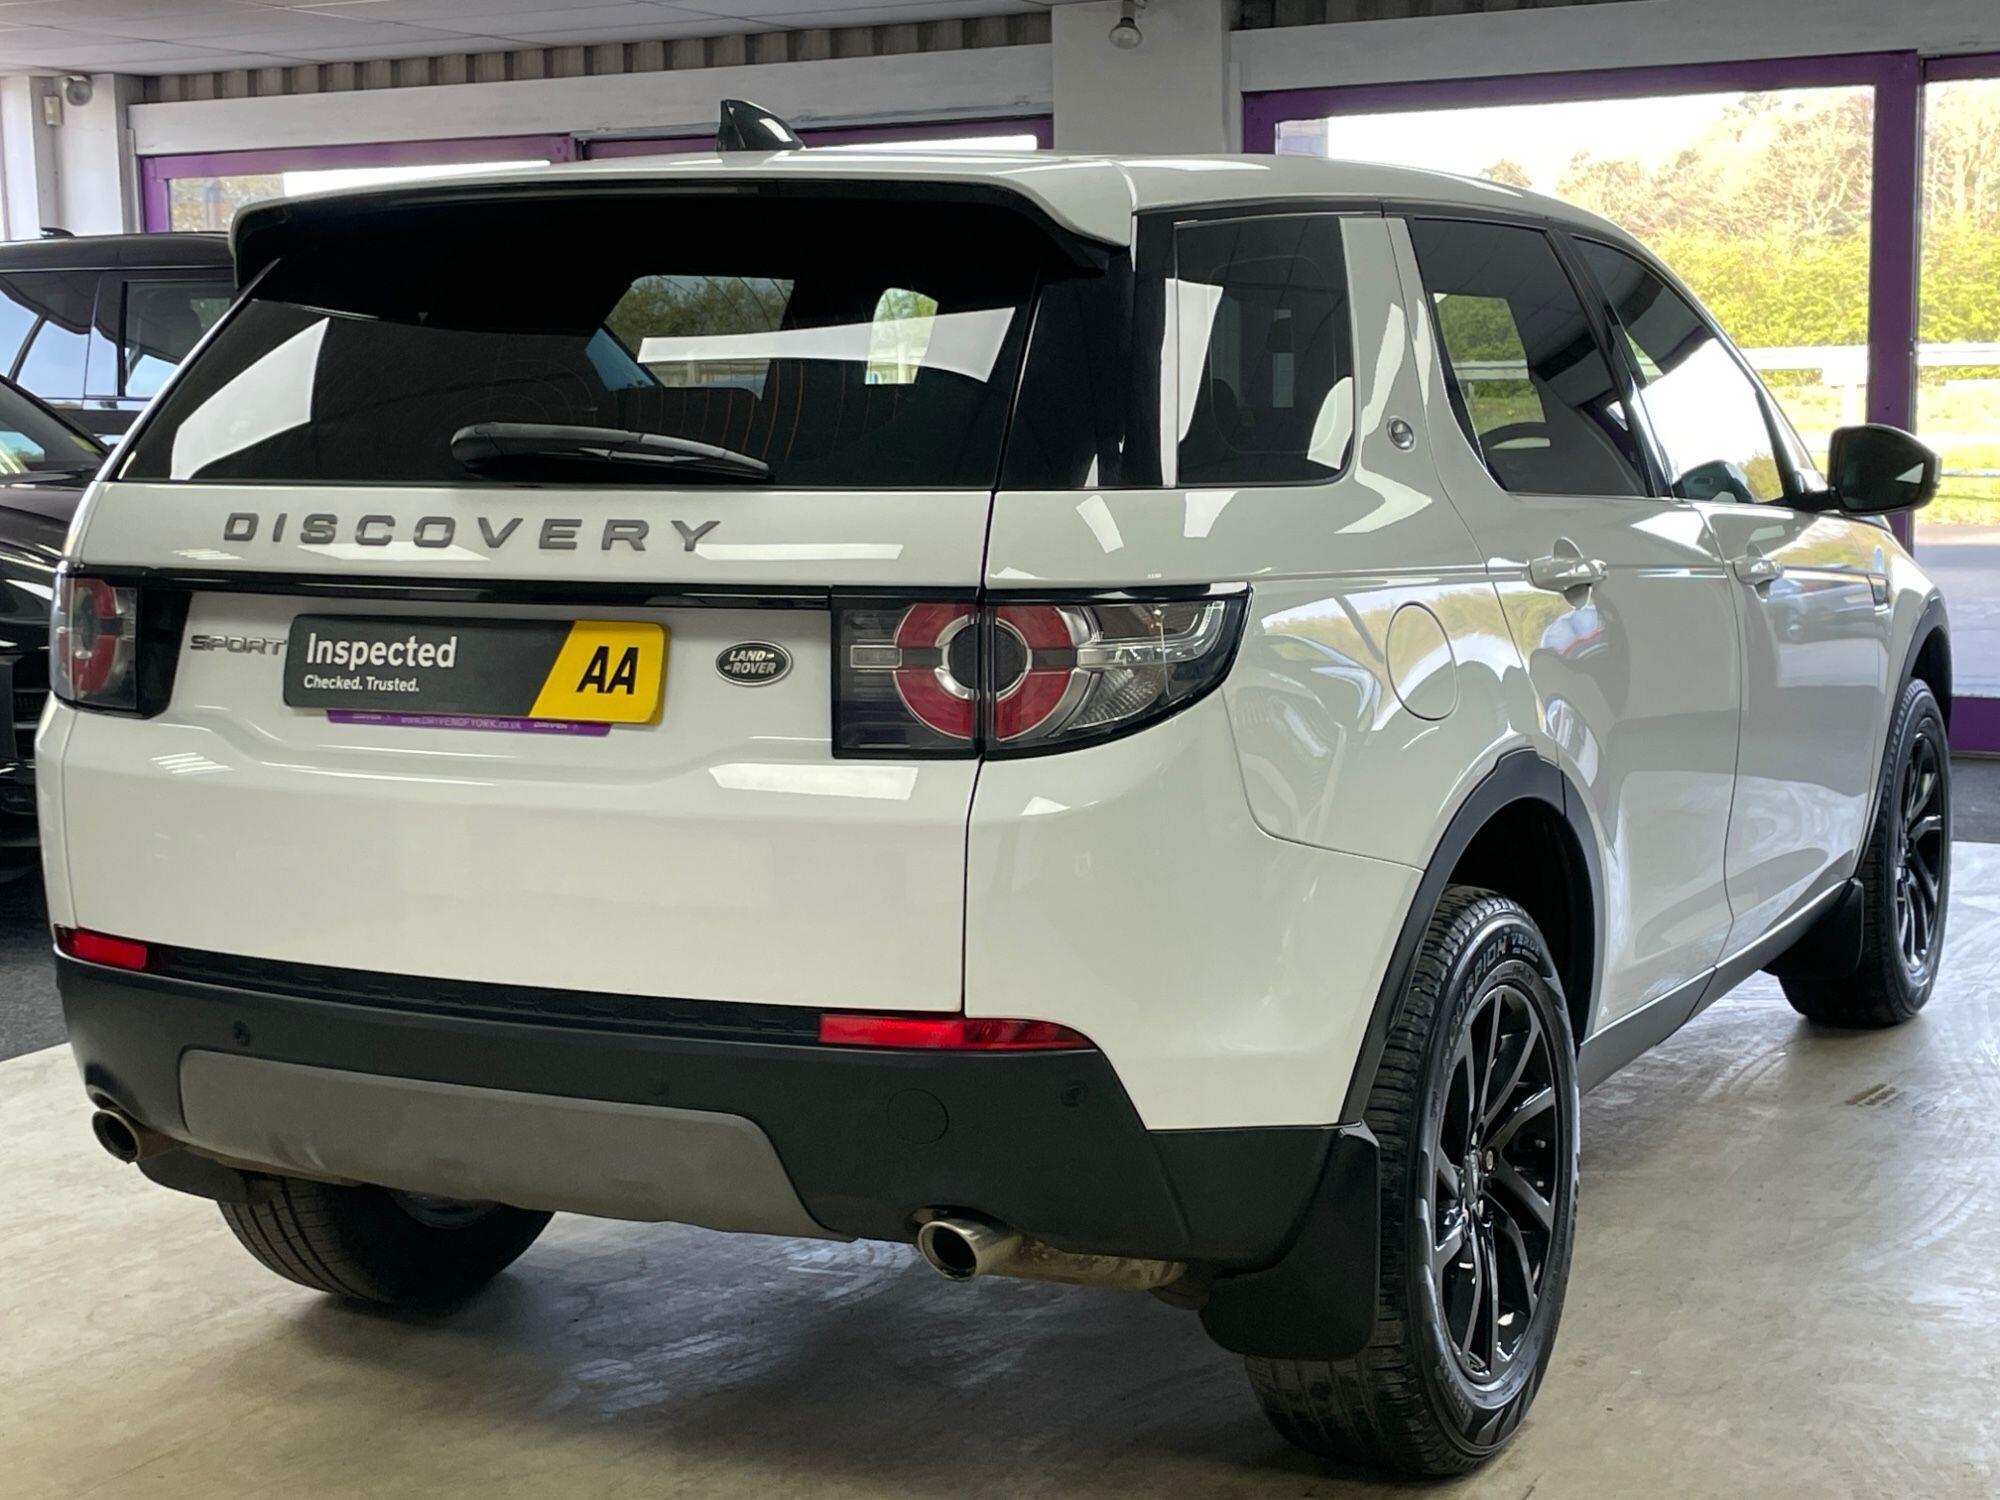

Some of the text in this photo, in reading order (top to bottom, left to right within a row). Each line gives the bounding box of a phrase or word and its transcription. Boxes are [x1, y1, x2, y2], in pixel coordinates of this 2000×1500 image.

[223, 512, 721, 552] DISCOVERY
[190, 635, 287, 655] SPORT
[306, 633, 458, 671] Inspected
[729, 650, 767, 662] LAND
[576, 645, 639, 695] AA
[731, 662, 777, 674] ROVER
[303, 674, 420, 692] Checked. Trusted.
